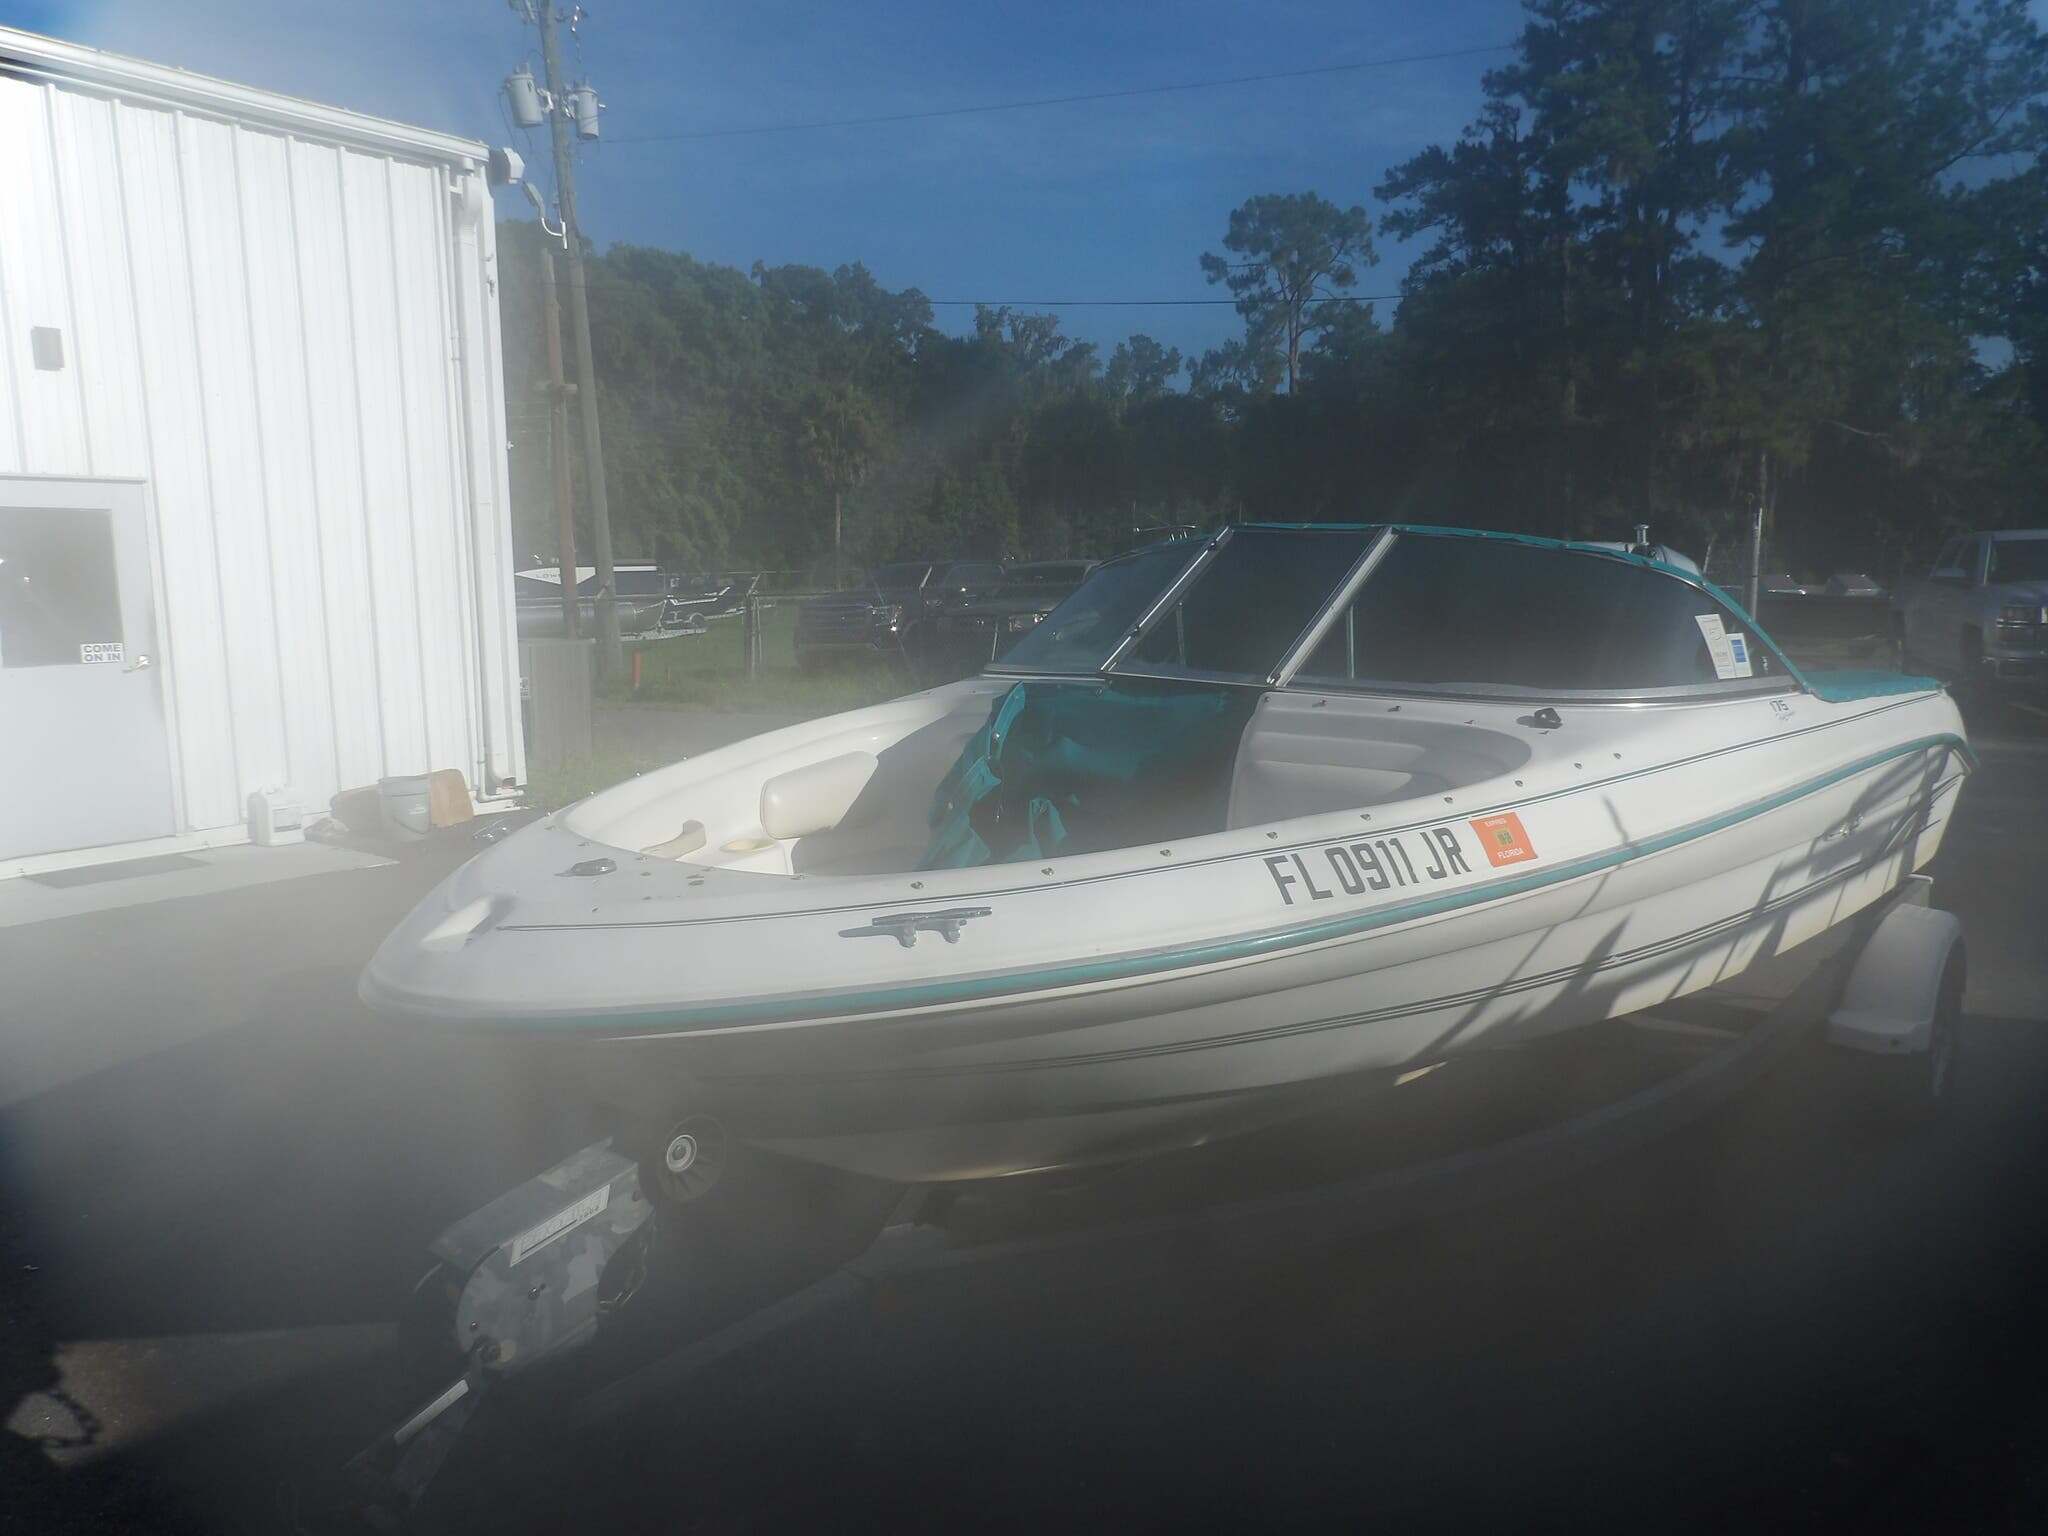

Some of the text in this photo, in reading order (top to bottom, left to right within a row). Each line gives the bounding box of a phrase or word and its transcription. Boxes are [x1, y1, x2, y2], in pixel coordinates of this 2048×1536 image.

[84, 645, 121, 653] COME
[84, 653, 120, 662] ON IN
[1496, 847, 1525, 859] FLORIDA
[1262, 827, 1473, 905] FL 0911 JR
